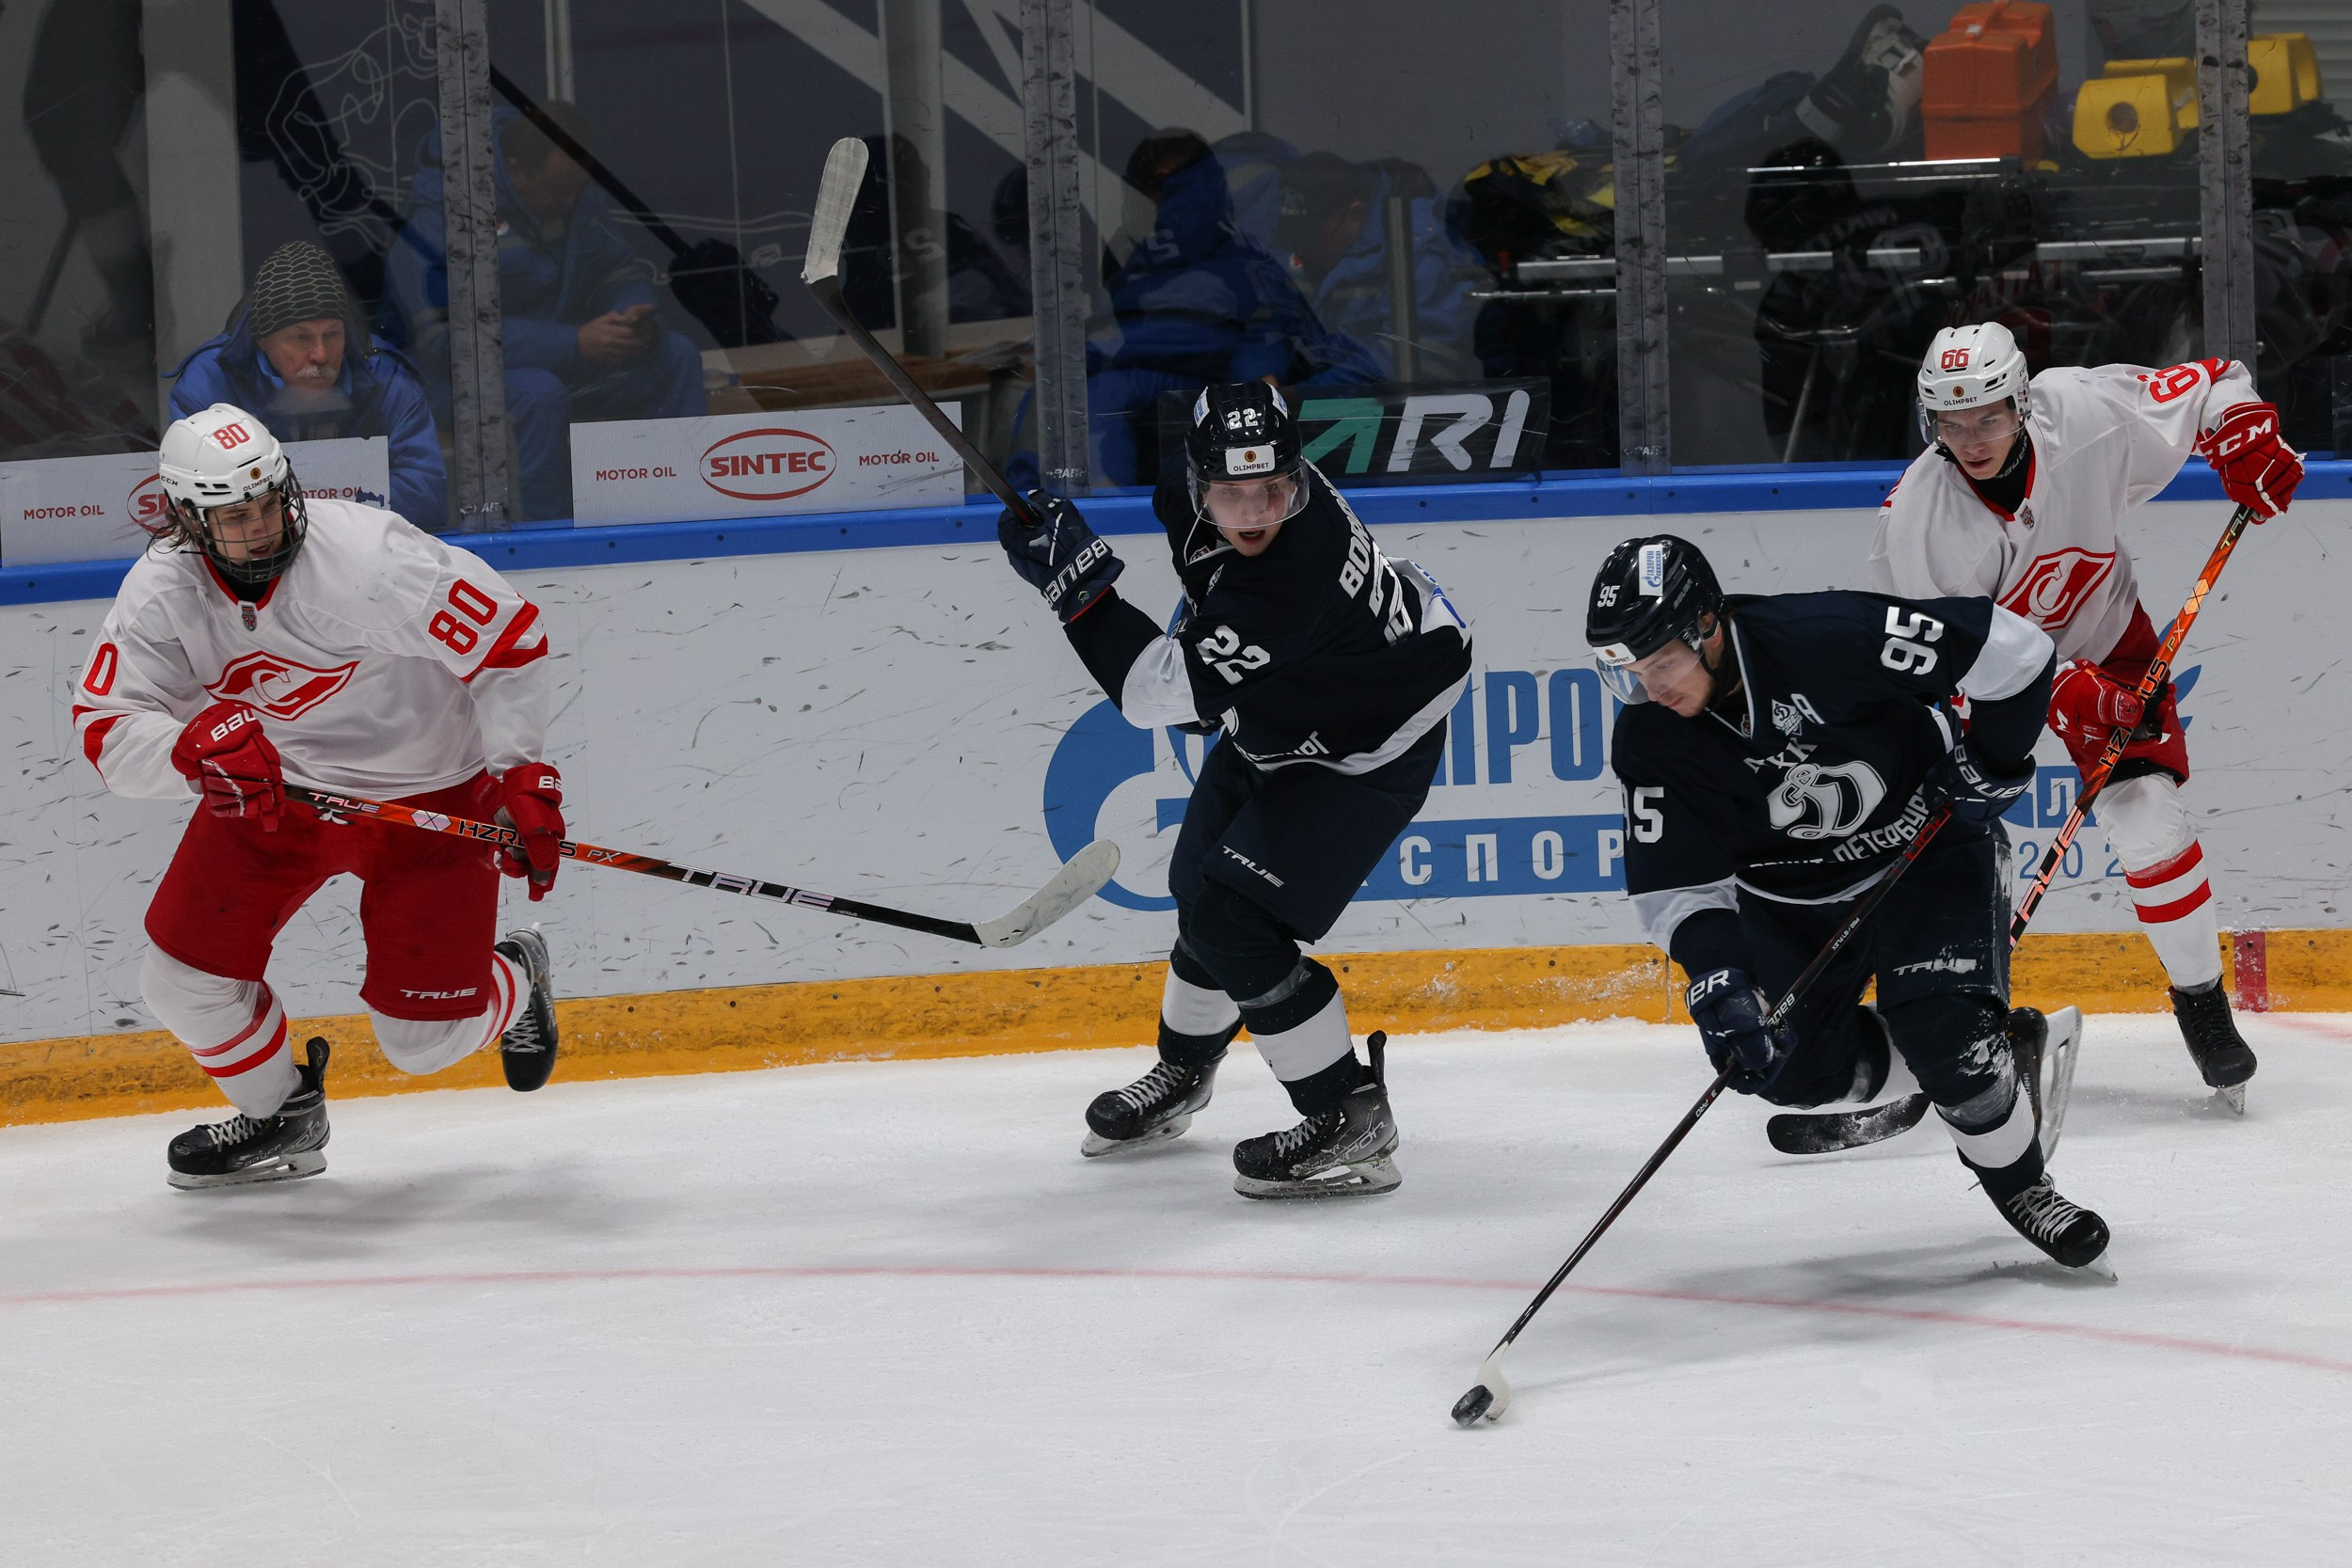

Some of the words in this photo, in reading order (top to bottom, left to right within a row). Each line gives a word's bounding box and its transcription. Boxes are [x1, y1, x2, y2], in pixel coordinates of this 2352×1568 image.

[1941, 348, 1970, 369] 66
[1943, 397, 1978, 406] OLIMPBET
[1227, 407, 1259, 430] 22
[213, 423, 250, 450] 80
[1296, 389, 1531, 473] ARI
[710, 451, 826, 478] SINTEC
[859, 452, 911, 467] MOTOR
[915, 451, 940, 464] OIL
[1233, 462, 1269, 472] OLIMPBET
[161, 475, 179, 486] CCM
[243, 473, 273, 492] OLIMPBET
[596, 467, 648, 481] MOTOR
[653, 467, 676, 478] OIL
[24, 506, 76, 520] MOTOR
[80, 505, 104, 517] OIL
[1597, 585, 1621, 608] 95
[428, 578, 498, 656] 80
[1880, 607, 1945, 676] 95
[2167, 618, 2185, 653] PX
[1196, 625, 1271, 686] 22
[309, 792, 380, 813] TRUE
[586, 848, 621, 863] PX
[1222, 846, 1285, 889] TRUE
[667, 860, 835, 912] TRUE
[400, 987, 477, 1001] TRUE
